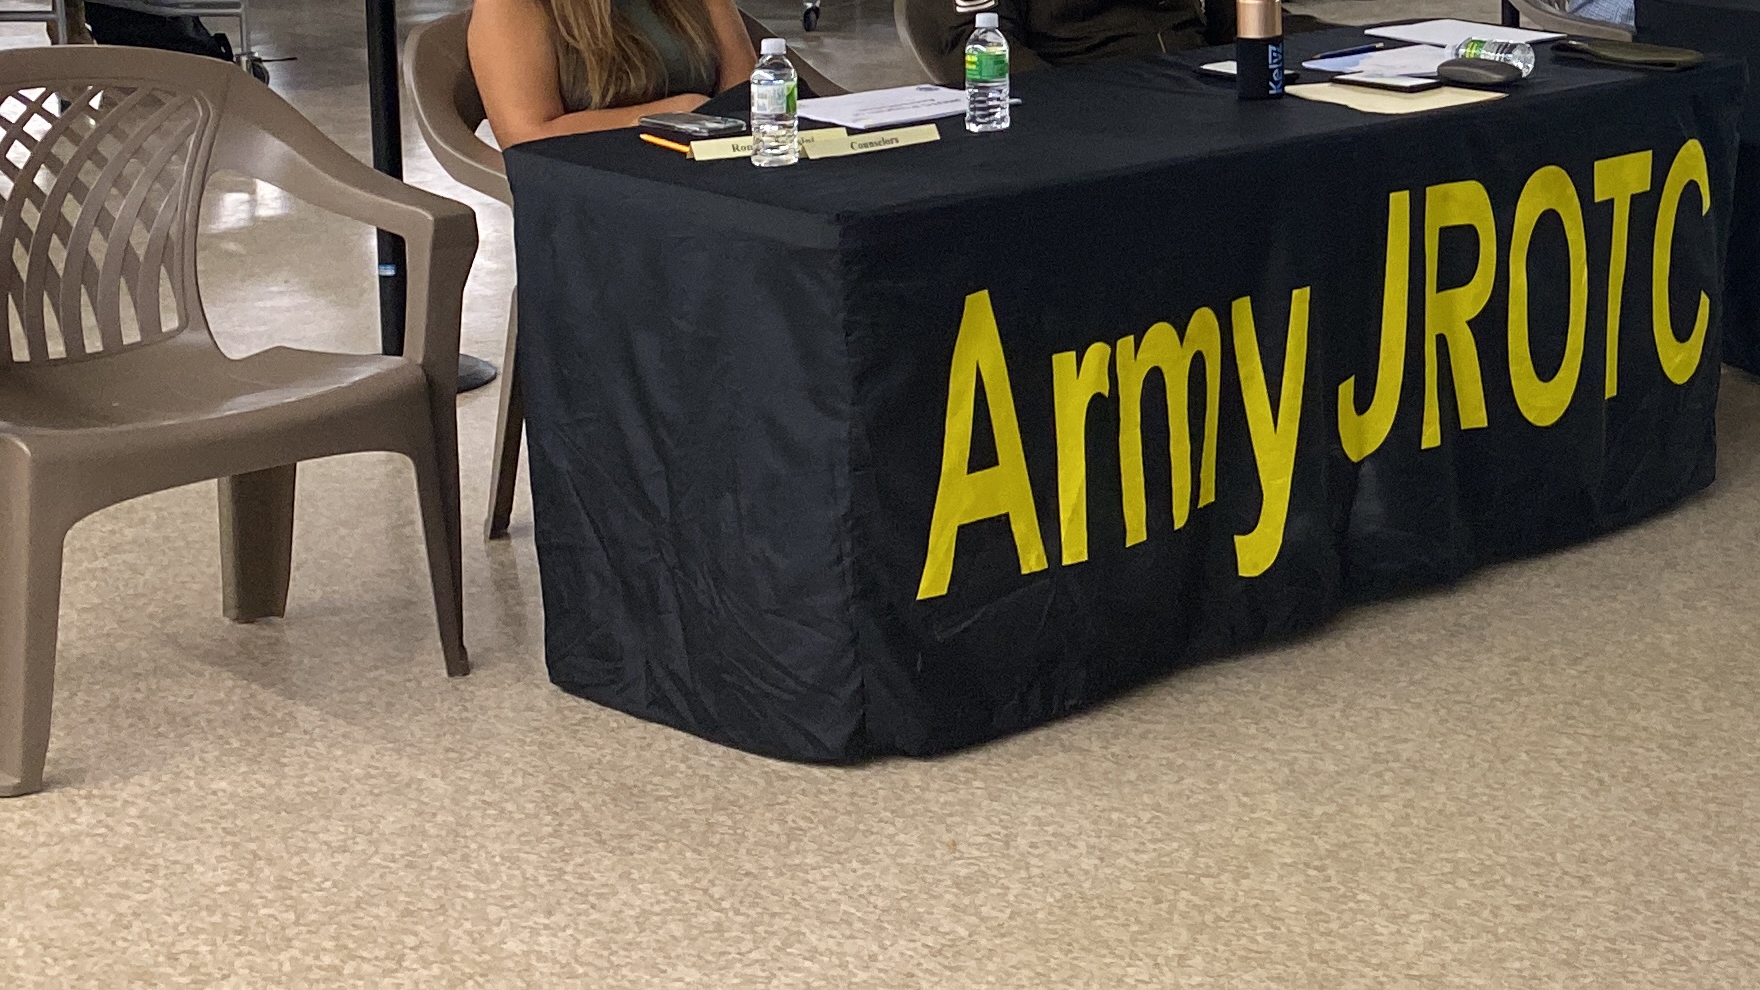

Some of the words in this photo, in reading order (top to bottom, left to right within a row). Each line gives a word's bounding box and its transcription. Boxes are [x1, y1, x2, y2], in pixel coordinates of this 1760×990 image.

[850, 136, 900, 151] Counselors
[917, 287, 1312, 601] Army
[1337, 138, 1713, 463] JROTC
